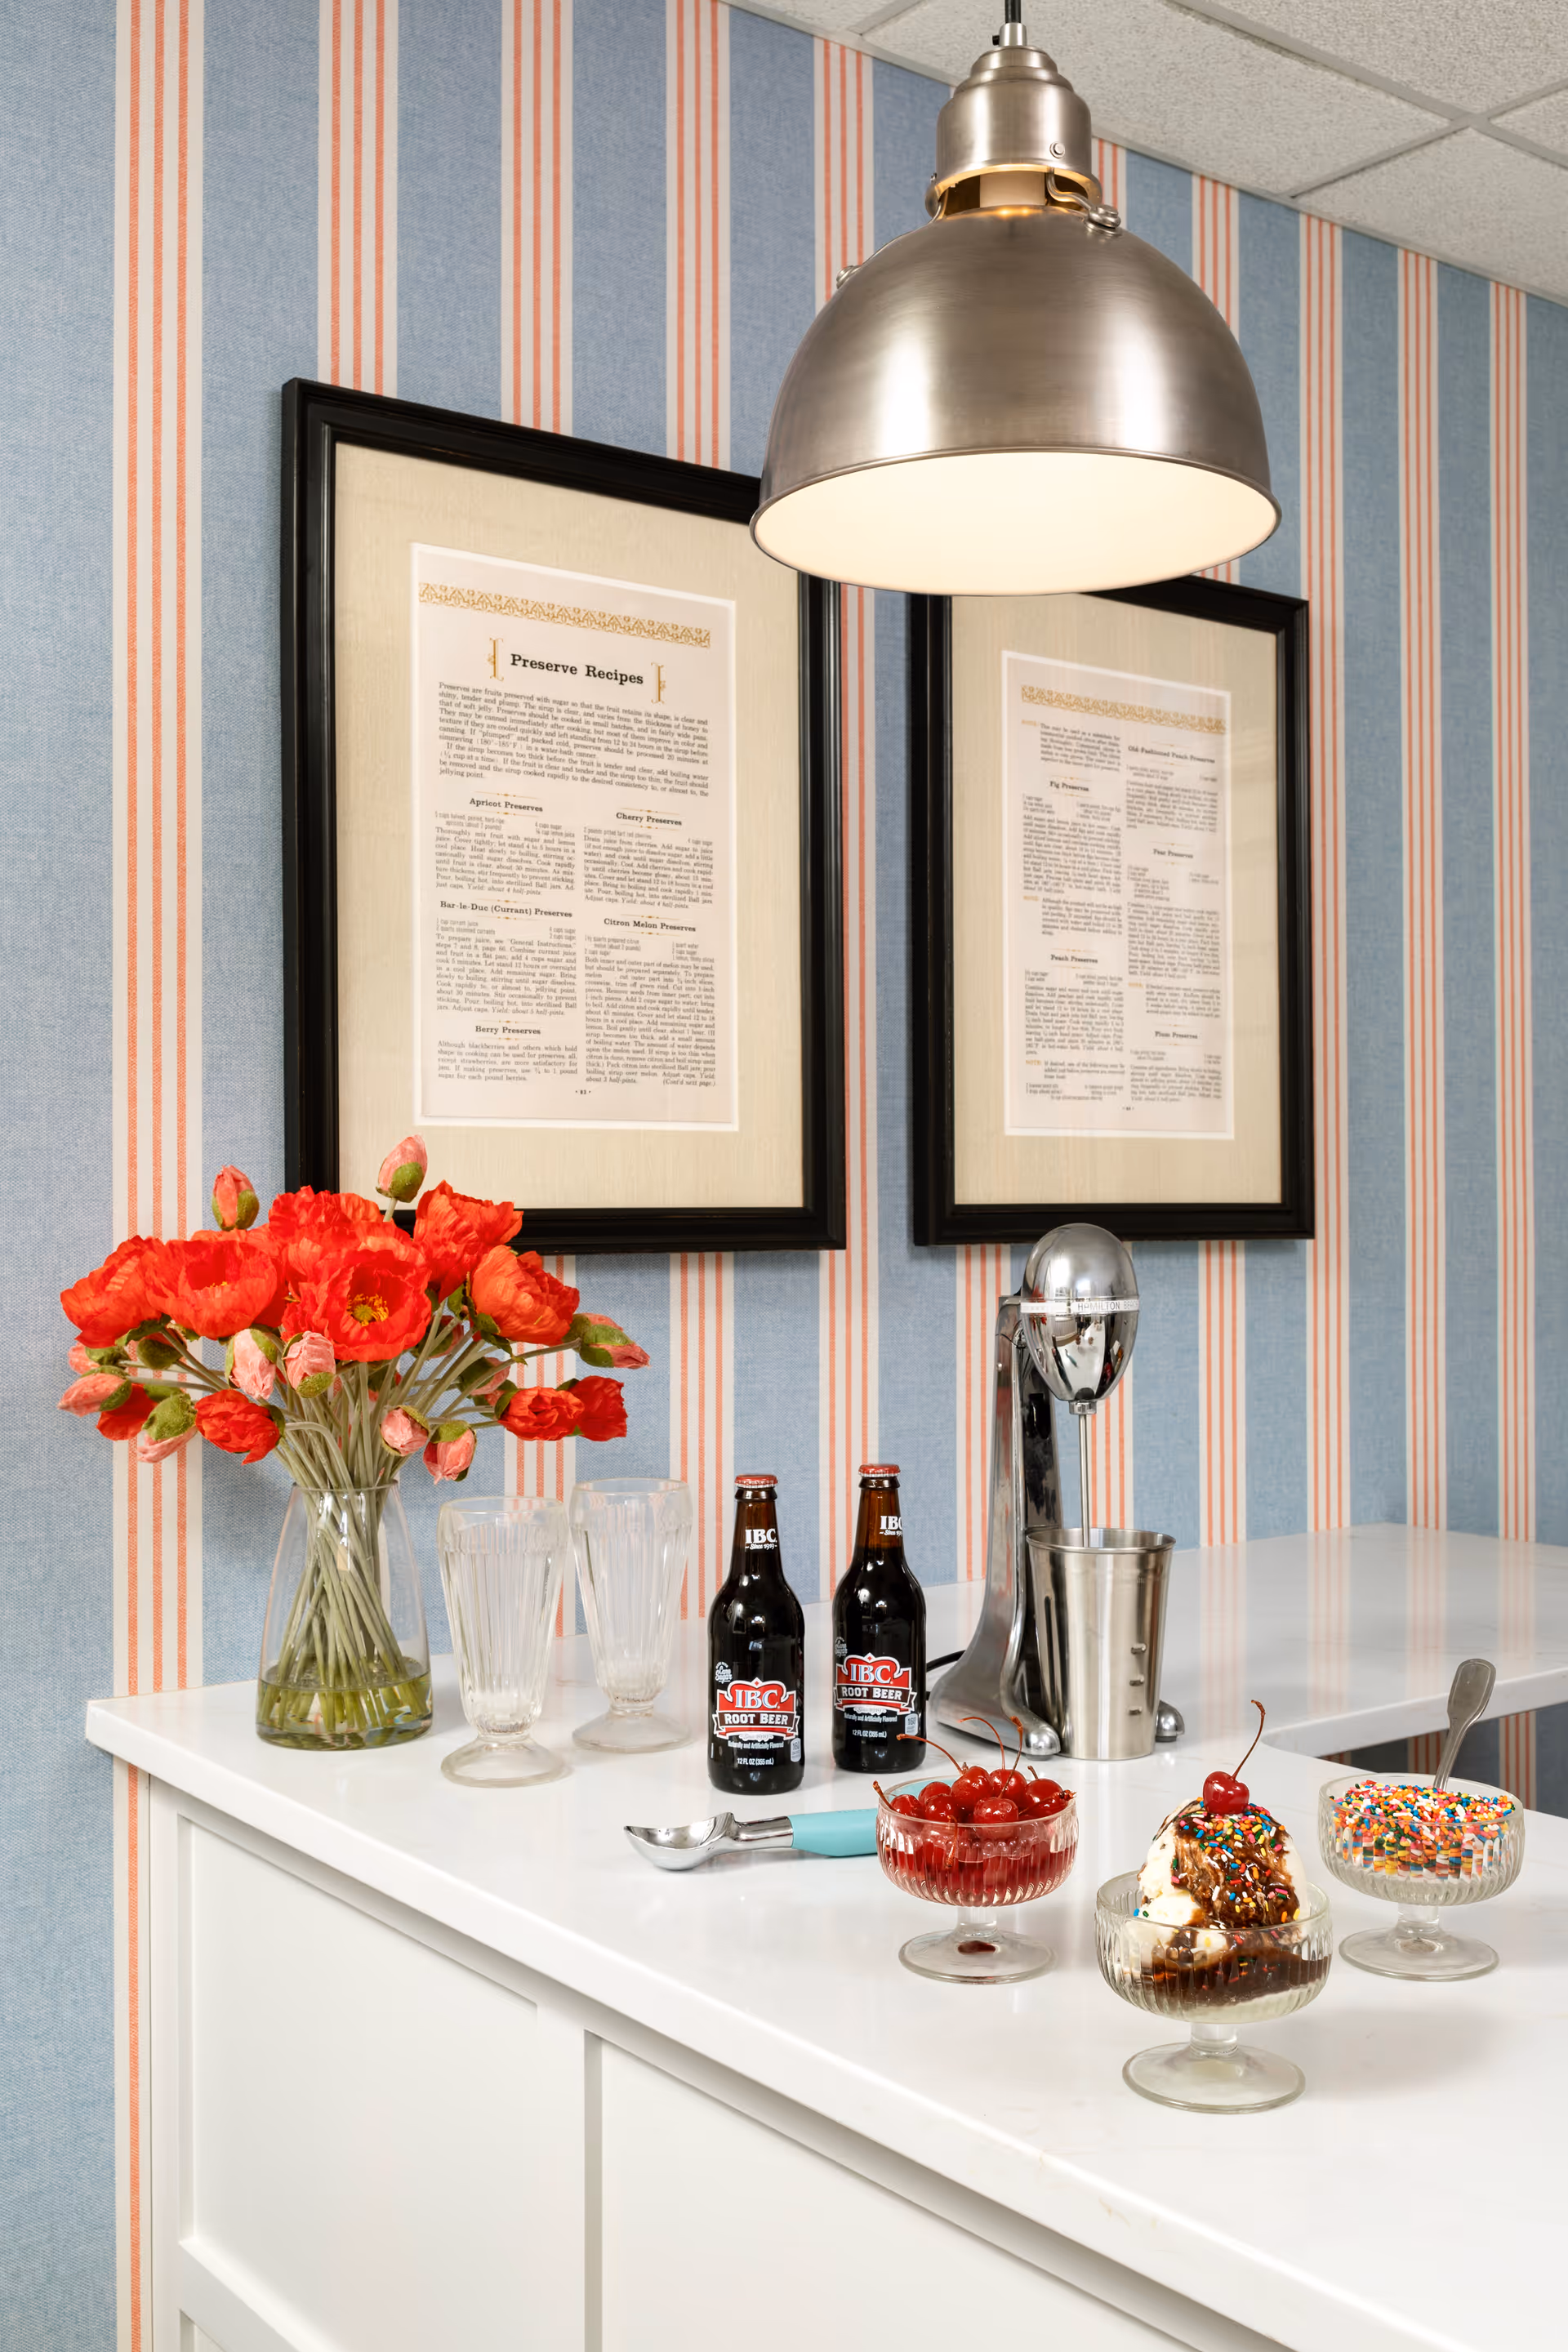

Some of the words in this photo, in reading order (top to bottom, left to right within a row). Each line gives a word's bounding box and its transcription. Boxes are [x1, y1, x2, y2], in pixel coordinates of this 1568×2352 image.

[510, 653, 577, 674] Preserve
[585, 664, 643, 685] Recipes
[439, 681, 469, 692] Preserves
[484, 688, 502, 696] fruits
[504, 692, 534, 701] preserved
[653, 712, 672, 720] shape,
[438, 690, 458, 699] shiny,
[498, 698, 519, 708] plump.
[564, 707, 580, 716] clear,
[645, 719, 672, 728] thickness
[682, 723, 699, 733] honey
[439, 707, 456, 716] They
[509, 716, 548, 728] immediately
[566, 725, 591, 734] cooking,
[467, 745, 484, 754] sirup
[486, 747, 513, 756] becomes
[580, 758, 593, 766] fruit
[638, 766, 654, 774] clear,
[670, 770, 689, 779] boiling
[439, 767, 464, 777] jellying
[1050, 780, 1059, 789] Fig
[1062, 782, 1089, 792] Preserves
[469, 798, 501, 807] Apricot
[504, 801, 543, 811] Preserves
[616, 812, 643, 822] Cherry
[646, 815, 681, 825] Preserves
[435, 826, 470, 836] Thoroughly
[1168, 849, 1193, 858] Preserves
[440, 900, 488, 911] Bar-le-Duc
[491, 905, 531, 915] (Currant)
[534, 908, 572, 917] Preserves
[604, 918, 629, 926] Citron
[633, 920, 657, 928] Melon
[660, 922, 695, 931] Preserves
[1070, 955, 1098, 964] Preserves
[475, 1025, 498, 1034] Berry
[1077, 1301, 1120, 1312] HAMILTON
[745, 1528, 776, 1544] IBC
[850, 1663, 891, 1684] IBC
[735, 1689, 778, 1708] IBC
[841, 1686, 869, 1698] ROOT
[872, 1687, 902, 1700] BEER
[724, 1713, 756, 1724] ROOT
[760, 1713, 788, 1725] BEER
